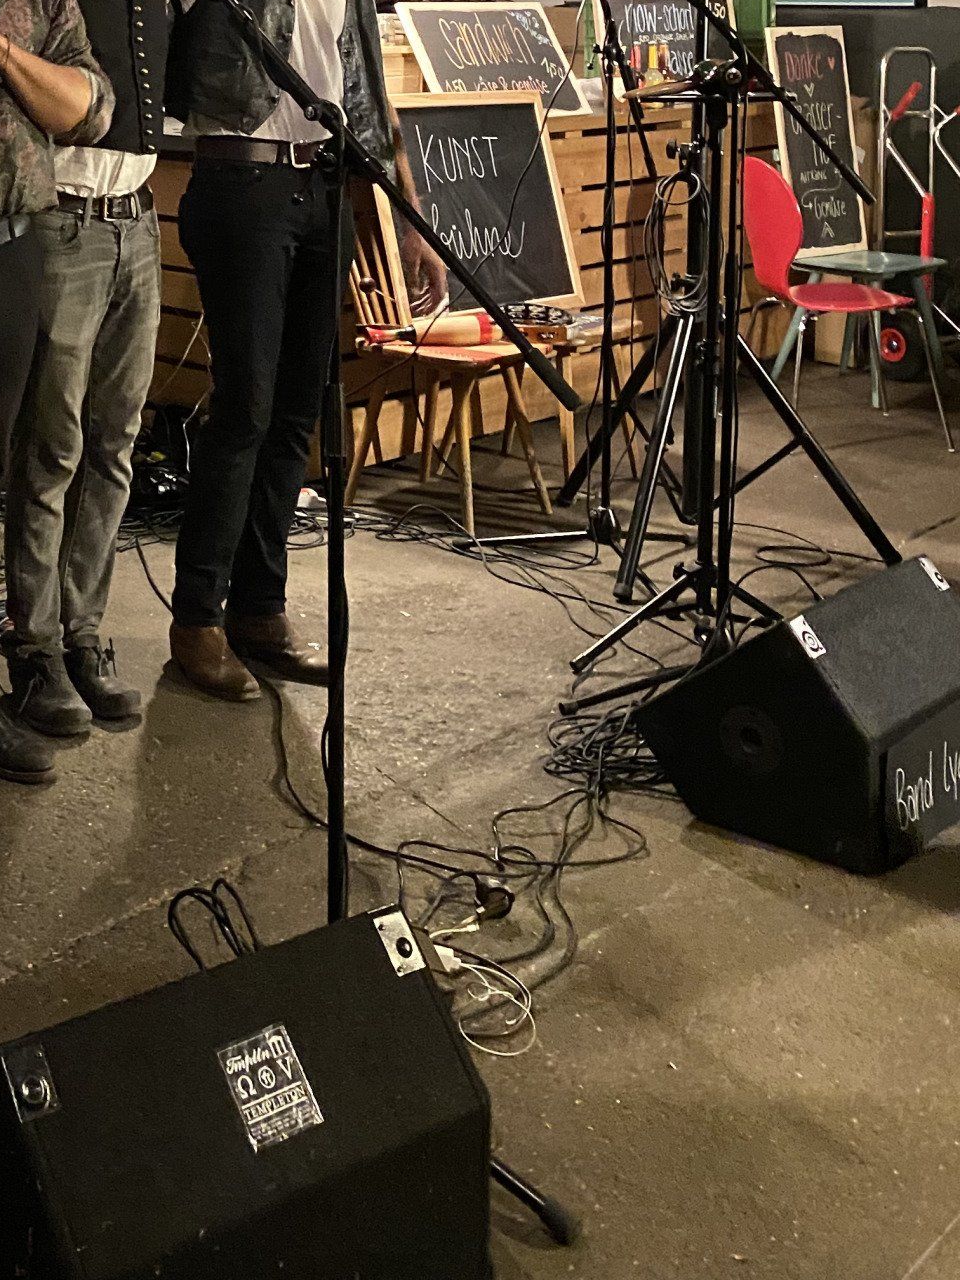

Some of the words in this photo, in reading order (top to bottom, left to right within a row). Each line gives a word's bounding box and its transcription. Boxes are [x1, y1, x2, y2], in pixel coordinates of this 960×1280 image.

[415, 124, 499, 194] KUNST
[896, 766, 935, 832] Band
[243, 1085, 307, 1121] TEMPLETON
